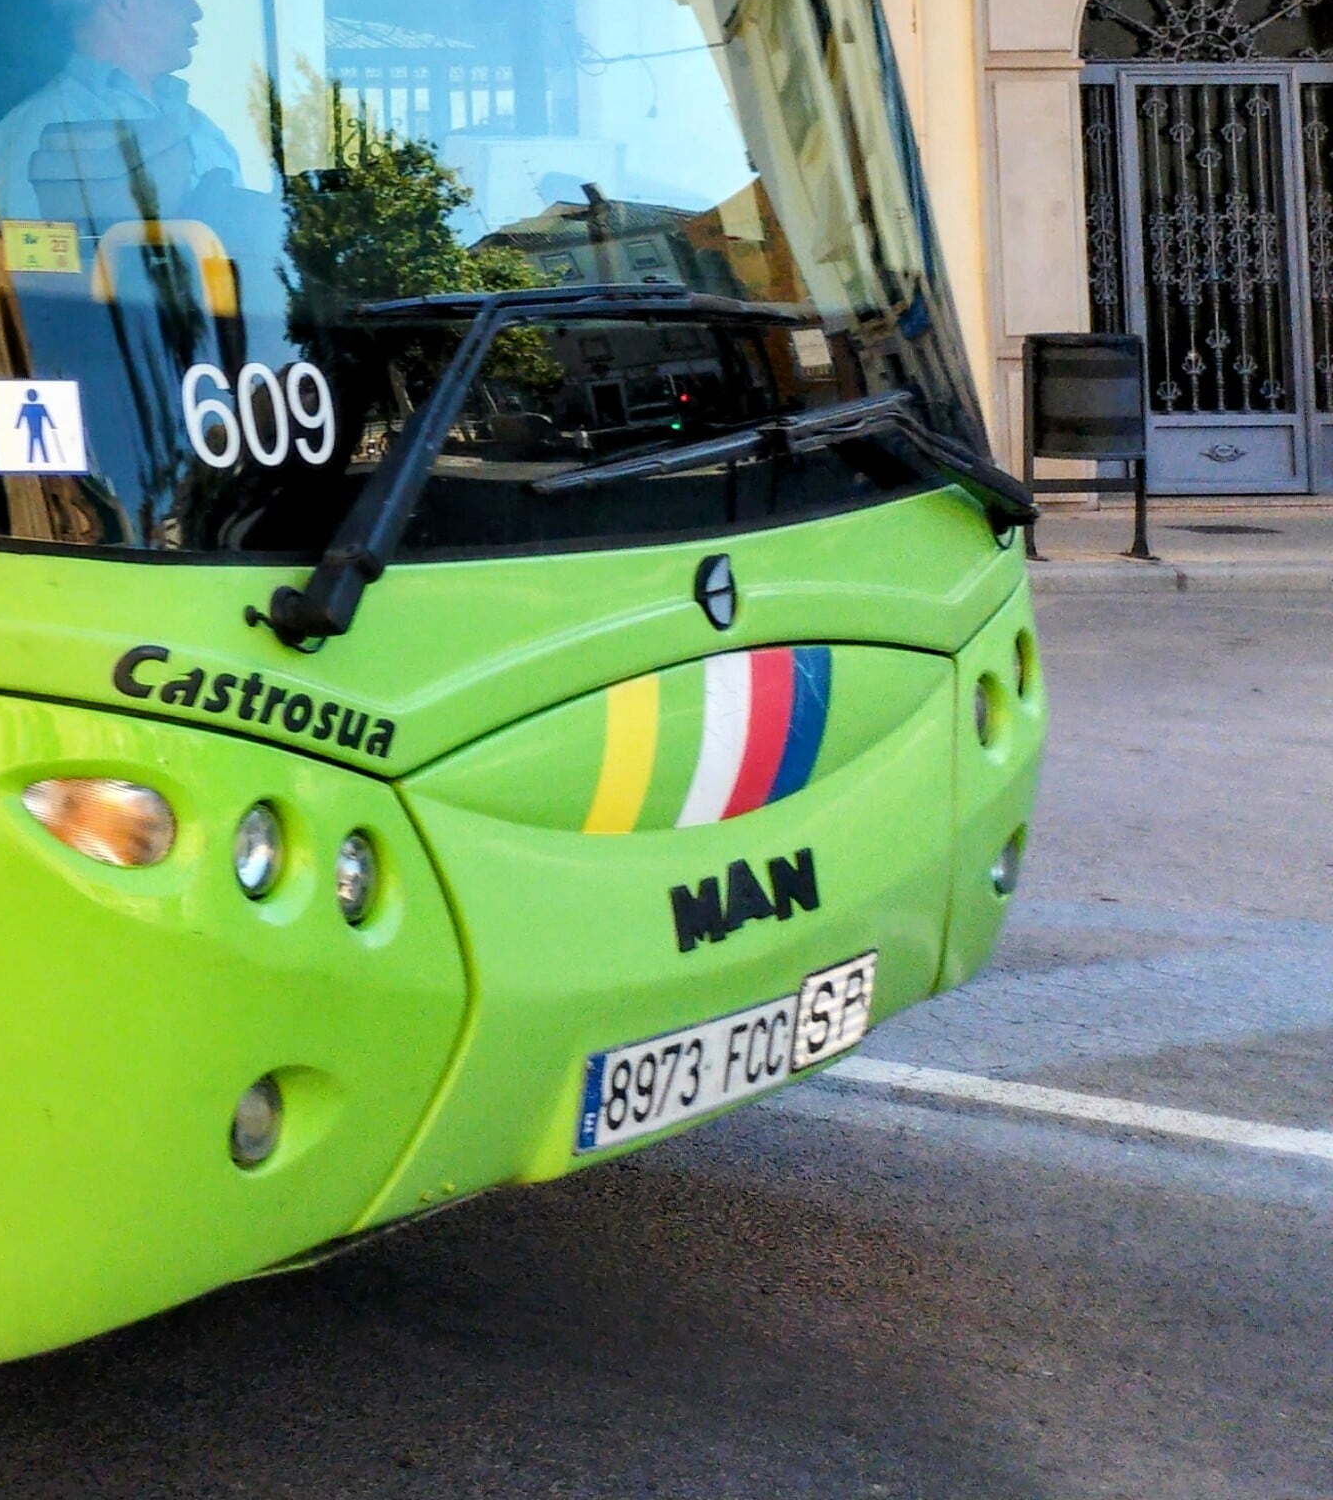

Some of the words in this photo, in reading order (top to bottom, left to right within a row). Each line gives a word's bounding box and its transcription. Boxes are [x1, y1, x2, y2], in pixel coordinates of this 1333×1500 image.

[182, 362, 334, 469] 609
[113, 645, 397, 759] Castrosua
[670, 847, 819, 953] MAN
[605, 1038, 703, 1130] 8973
[723, 1010, 786, 1093] FCC
